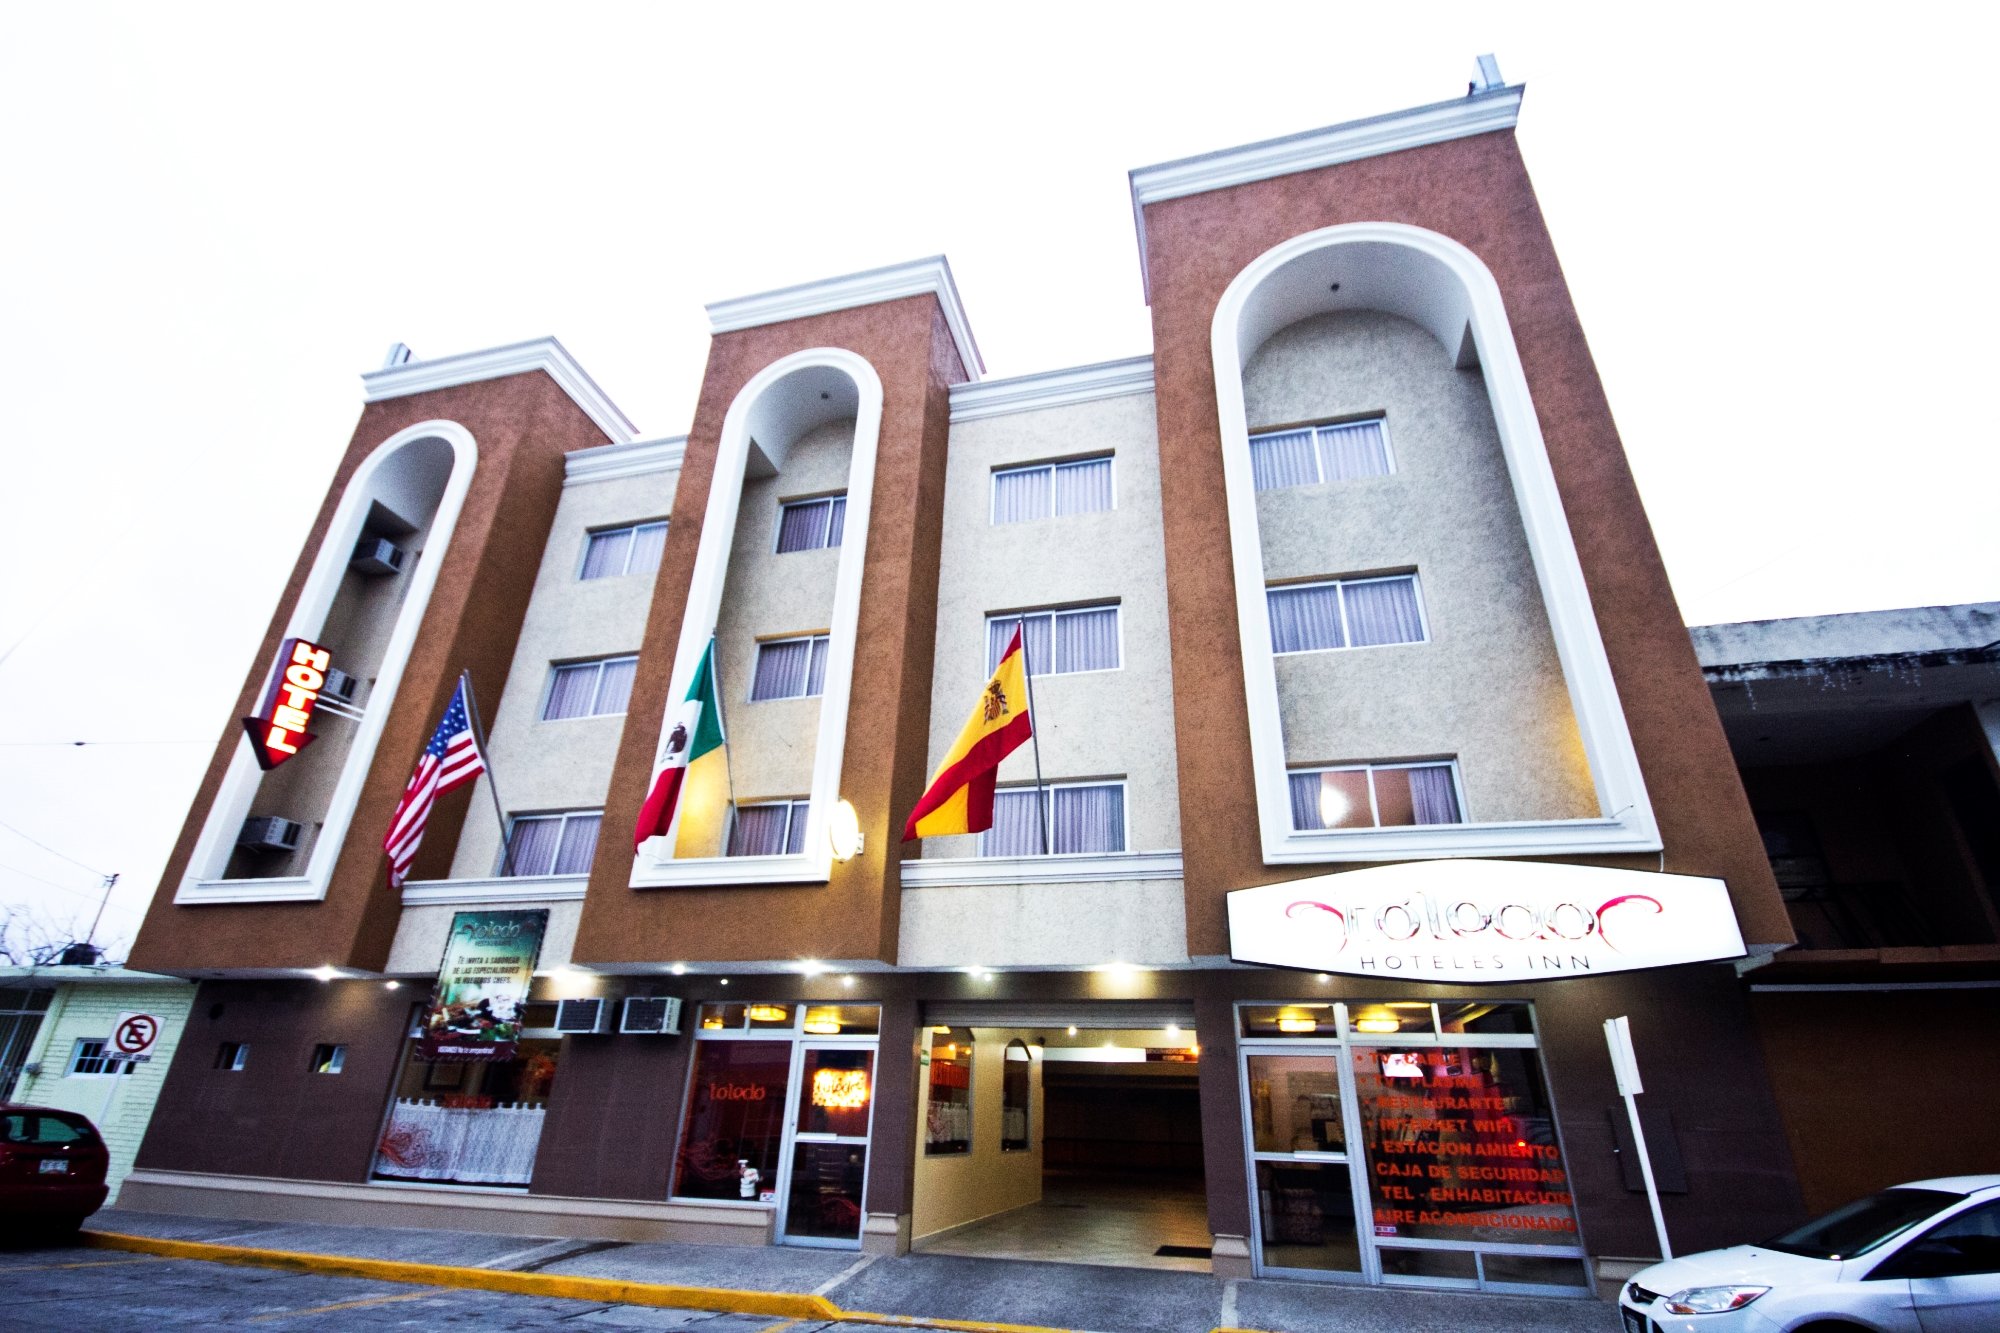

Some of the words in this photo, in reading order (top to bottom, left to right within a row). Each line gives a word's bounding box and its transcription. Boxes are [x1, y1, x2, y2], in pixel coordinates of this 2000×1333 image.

[265, 642, 330, 754] HOTEL
[1360, 955, 1504, 970] HOTELES
[1527, 955, 1590, 970] INN
[1404, 1053, 1460, 1067] CABLE
[1373, 1074, 1393, 1088] TV
[1411, 1076, 1484, 1089] PLASMA
[1376, 1096, 1505, 1110] RESTAURANTE
[1380, 1118, 1467, 1133] INTERNET
[1377, 1162, 1422, 1178] CAJA
[1429, 1165, 1452, 1180] DE
[1458, 1165, 1566, 1184] SEGURIDAD
[1381, 1186, 1414, 1200] TEL
[1375, 1209, 1415, 1224] AIRE
[1420, 1210, 1576, 1233] ACONDICIONADO
